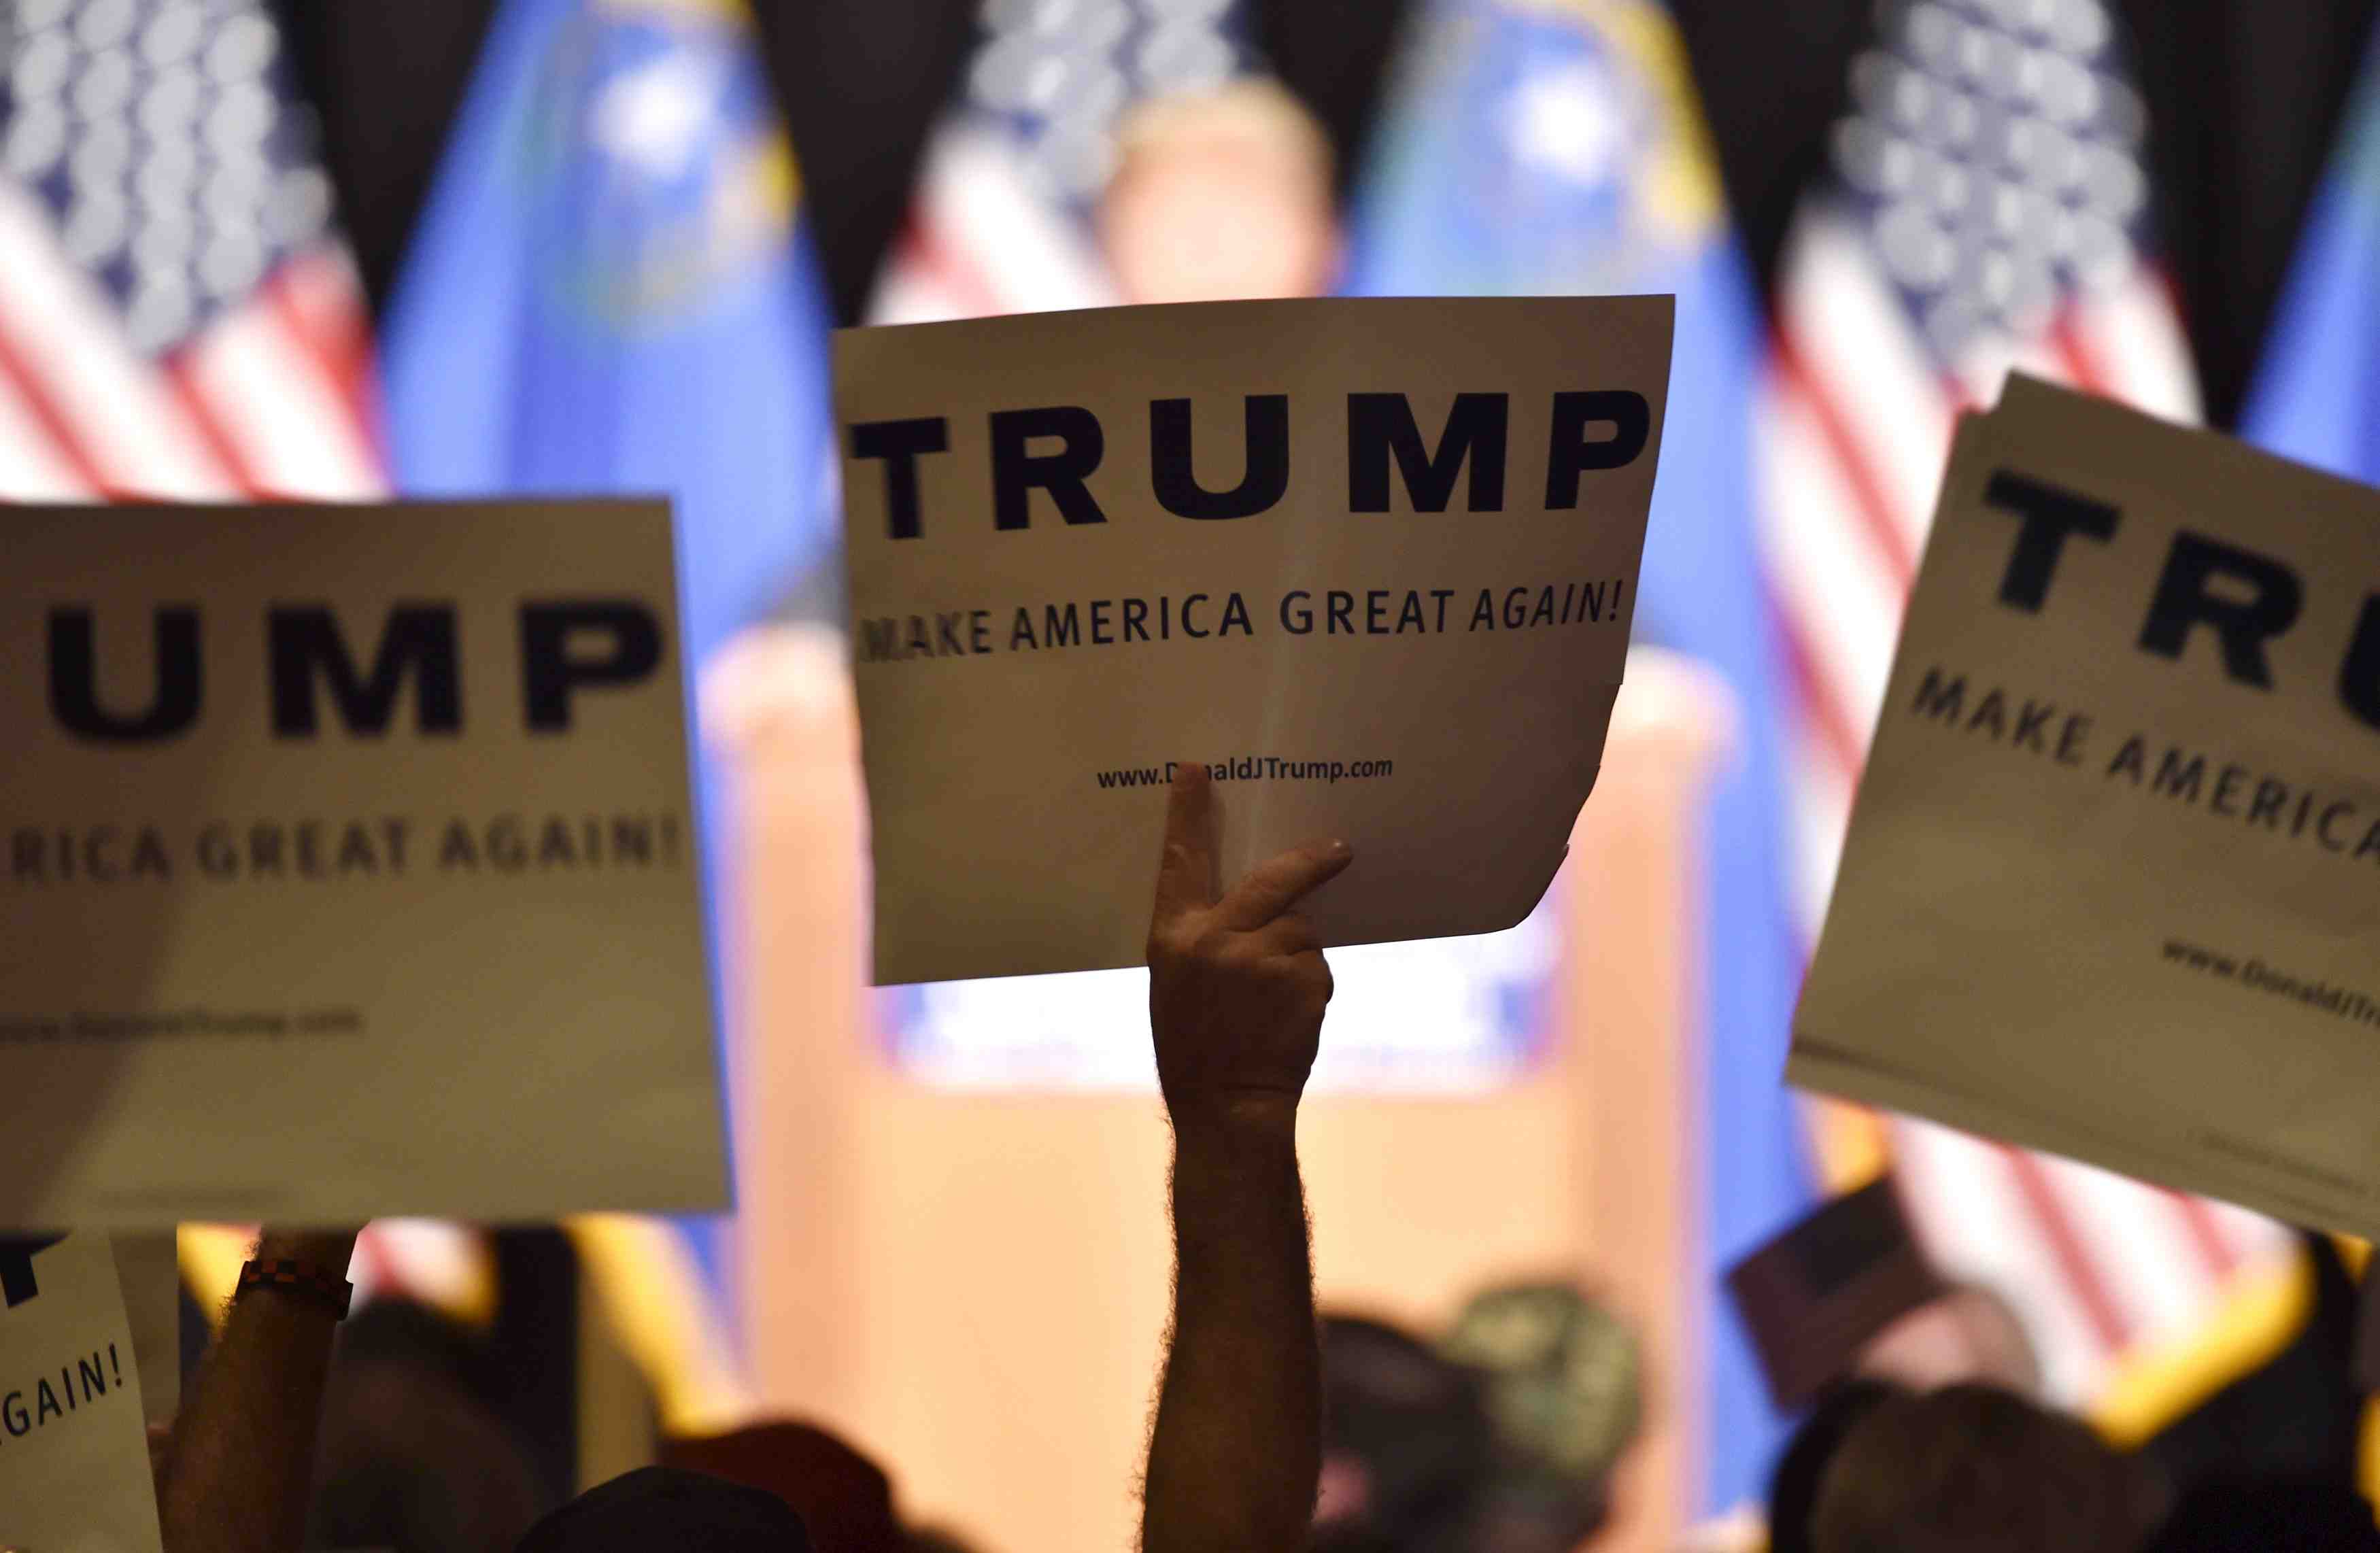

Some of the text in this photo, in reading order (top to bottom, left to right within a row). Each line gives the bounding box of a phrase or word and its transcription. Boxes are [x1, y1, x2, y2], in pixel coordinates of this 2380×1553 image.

[848, 390, 1650, 539] TRUMP
[46, 600, 664, 745] UMP
[859, 579, 1623, 663] MAKE AMERICA GREAT AGAIN!
[1912, 669, 2380, 865] MAKE AMERICA
[194, 819, 408, 883] GREAT
[439, 815, 679, 872] AGAIN!
[0, 1342, 123, 1446] GAIN!
